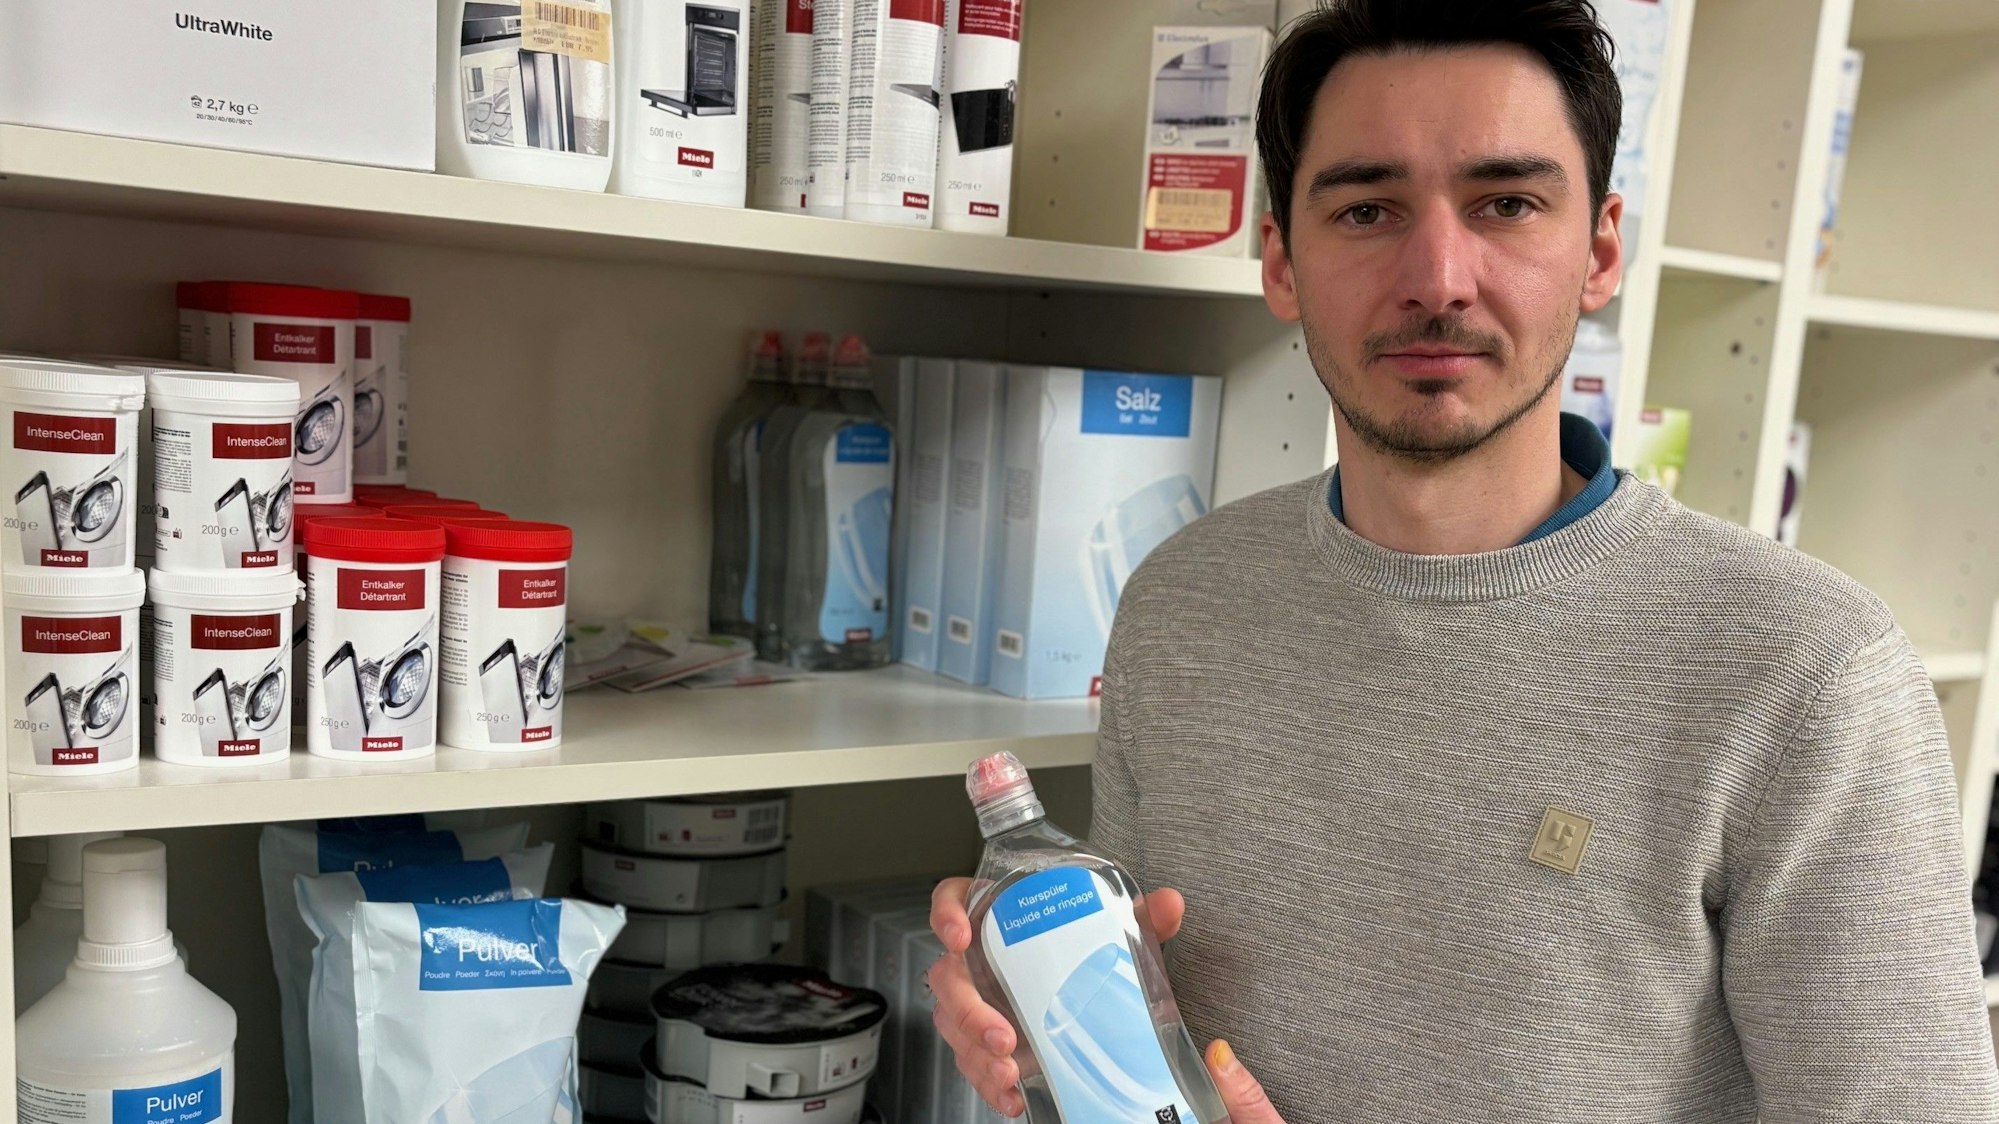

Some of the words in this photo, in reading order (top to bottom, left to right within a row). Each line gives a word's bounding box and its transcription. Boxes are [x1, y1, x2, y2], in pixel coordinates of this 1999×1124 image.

[176, 12, 273, 41] UltraWhite
[207, 98, 225, 111] 2,7
[229, 101, 244, 115] kg
[649, 126, 664, 137] 500
[665, 130, 674, 138] ml
[682, 152, 711, 164] Miele
[880, 172, 896, 183] 250
[947, 180, 962, 190] 250
[906, 195, 928, 205] Miele
[972, 205, 997, 216] Miele
[274, 332, 316, 344] Entkalker
[273, 344, 318, 355] Détartrant
[1115, 385, 1162, 412] Salz
[27, 426, 105, 441] IntenseClean
[227, 436, 287, 447] IntenseClean
[3, 517, 20, 529] 200
[20, 521, 26, 531] g
[201, 525, 220, 536] 200
[220, 528, 227, 537] g
[46, 553, 84, 563] Miele
[246, 555, 275, 564] Miele
[362, 580, 405, 590] Entkalker
[523, 579, 557, 589] Entkalker
[360, 591, 407, 601] Détartrant
[521, 590, 558, 600] Détartrant
[36, 629, 111, 641] IntenseClean
[204, 627, 272, 638] IntenseClean
[181, 713, 197, 723] 200
[199, 716, 204, 725] g
[320, 716, 334, 727] 250
[334, 720, 339, 729] g
[476, 713, 493, 722] 250
[493, 715, 499, 724] g
[13, 719, 30, 730] 200
[30, 723, 37, 733] g
[525, 730, 550, 739] Miele
[223, 743, 257, 752] Miele
[366, 741, 400, 749] Miele
[58, 752, 94, 761] Miele
[1017, 882, 1068, 908] Klarspüler
[1003, 910, 1041, 931] Liquide
[1042, 905, 1057, 916] de
[1058, 890, 1094, 911] rinçage
[458, 938, 538, 962] Pulver
[425, 971, 450, 979] Poudre
[146, 1089, 204, 1114] Pulver
[180, 1110, 202, 1121] Poeder
